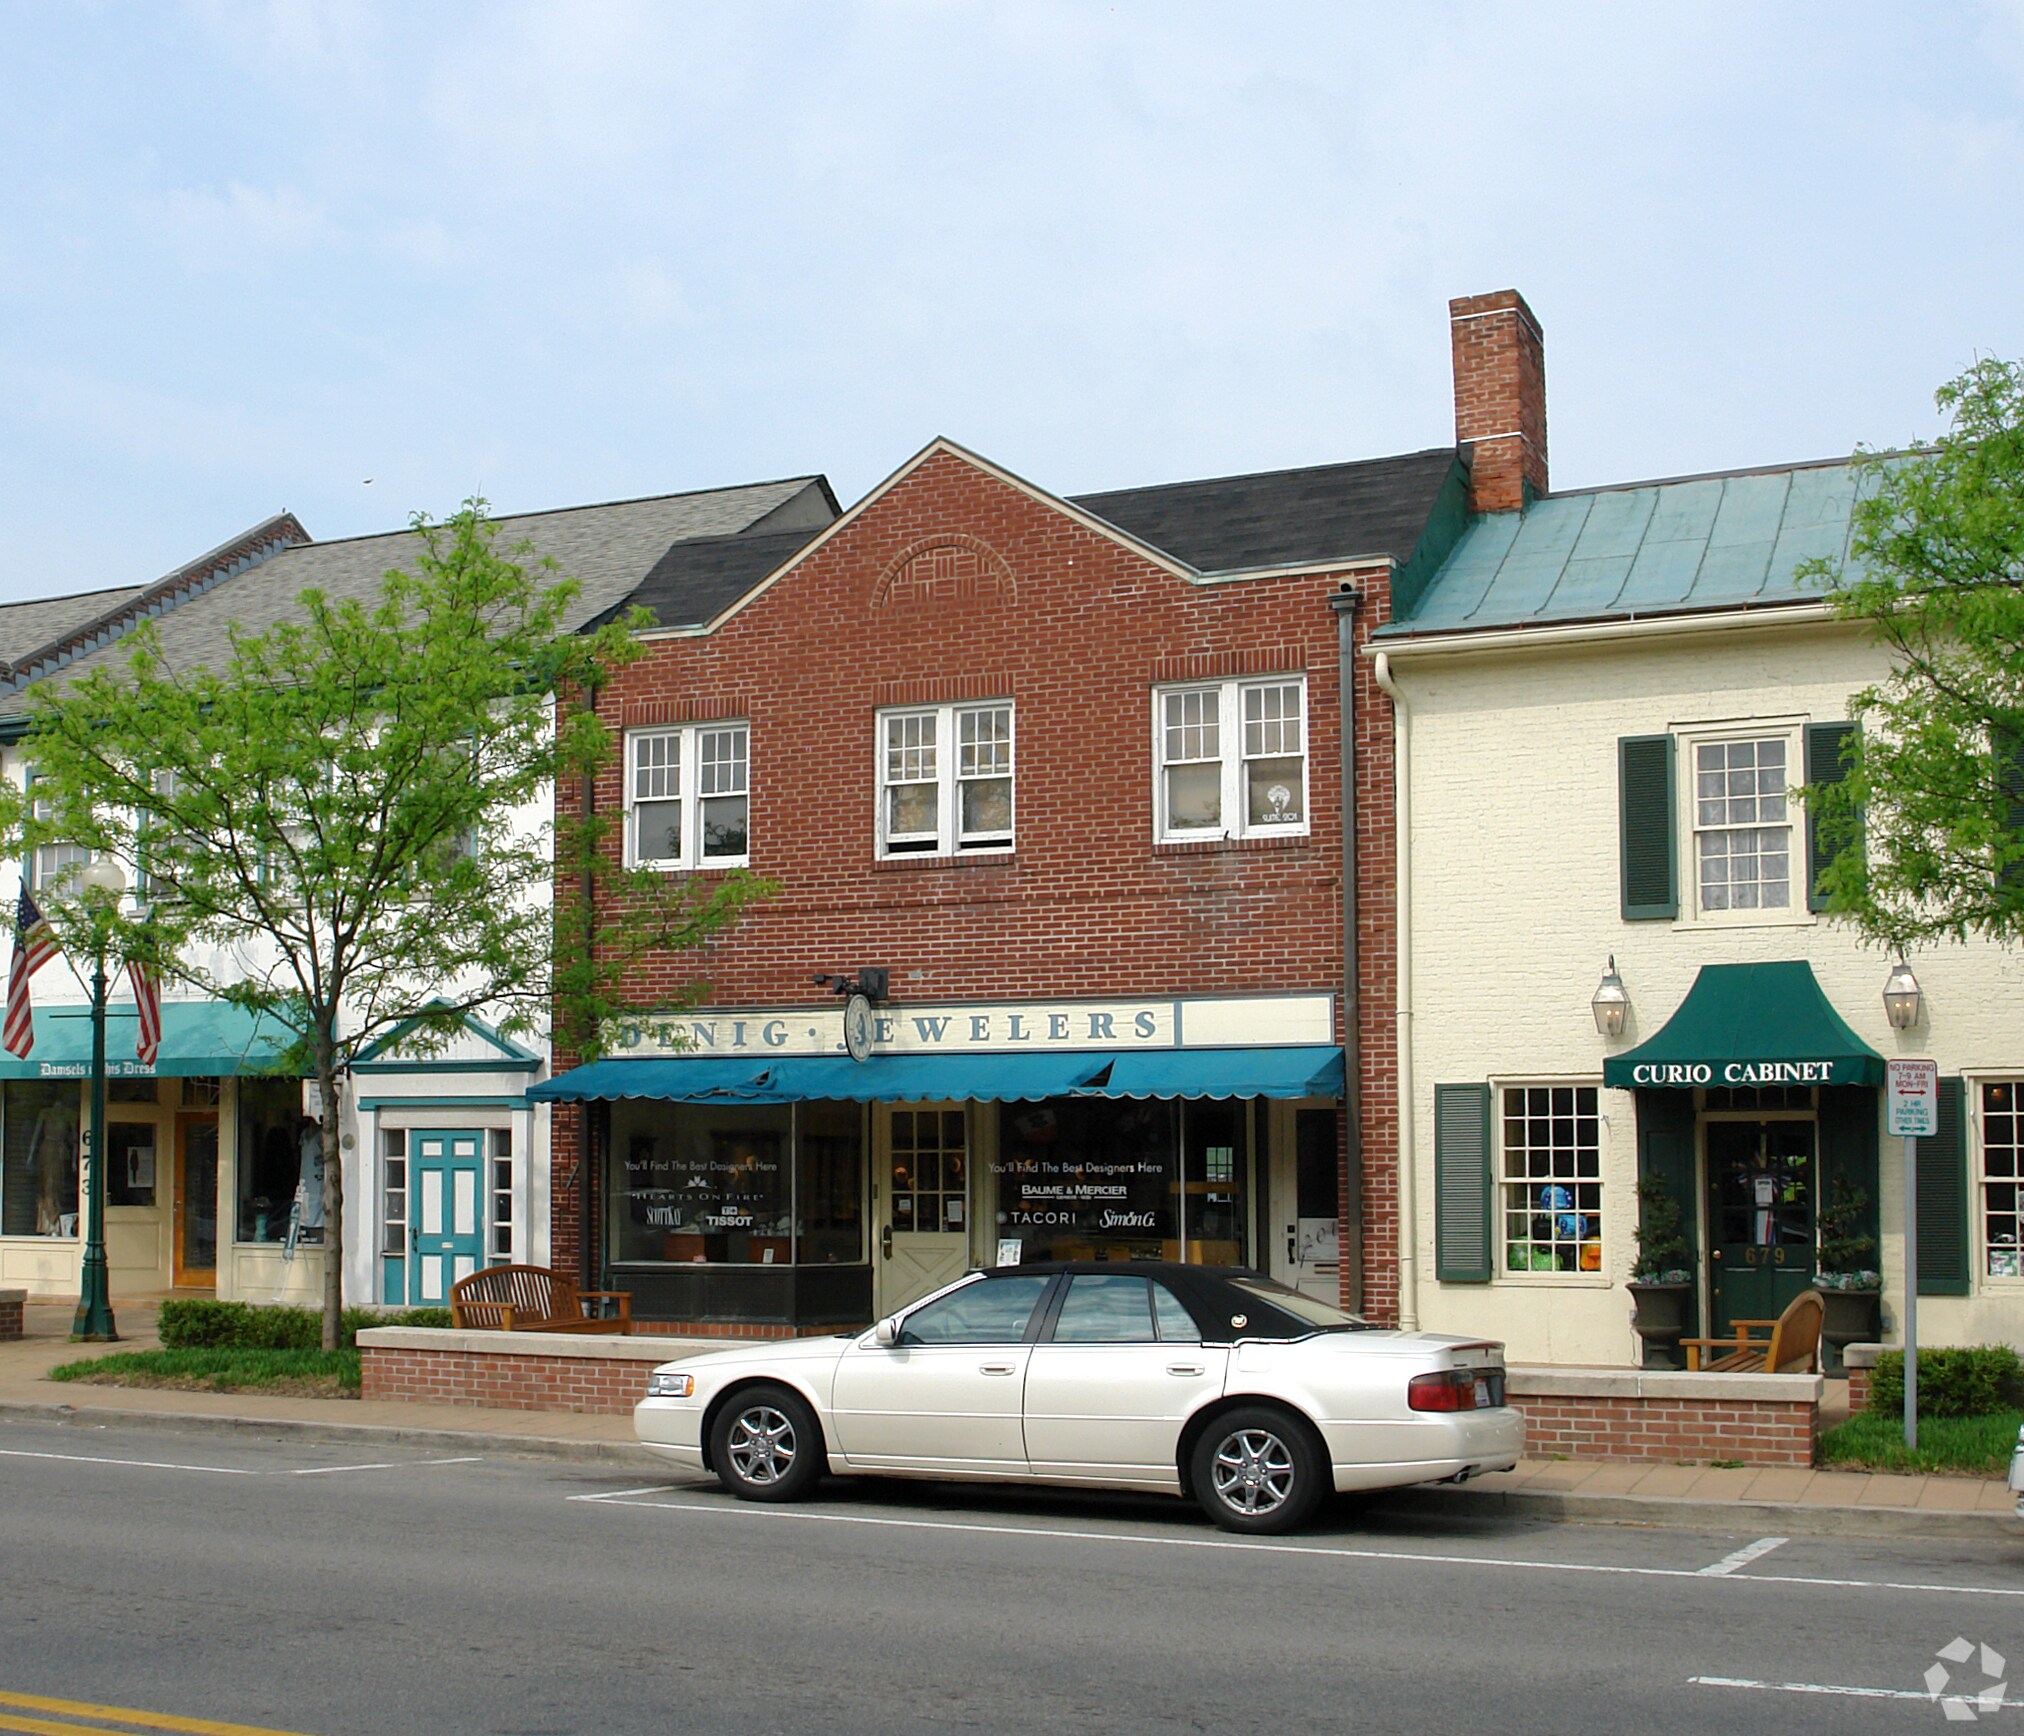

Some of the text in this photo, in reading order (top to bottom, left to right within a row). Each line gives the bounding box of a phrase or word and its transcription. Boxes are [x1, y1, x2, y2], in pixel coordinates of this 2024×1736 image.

[40, 1063, 86, 1076] Damsels
[123, 1061, 156, 1075] Dress
[1633, 1062, 1834, 1083] CURIO CABINET
[1896, 1108, 1928, 1116] PARKING
[624, 1160, 778, 1173] You'll Find The Best Designers Here
[988, 1162, 1163, 1175] You'll Find The Best Designers Here
[1021, 1185, 1064, 1195] BAUME
[1075, 1185, 1127, 1195] MERCIER
[705, 1216, 754, 1226] TISSOT
[1011, 1211, 1076, 1224] TACORI
[1744, 1246, 1785, 1265] 679
